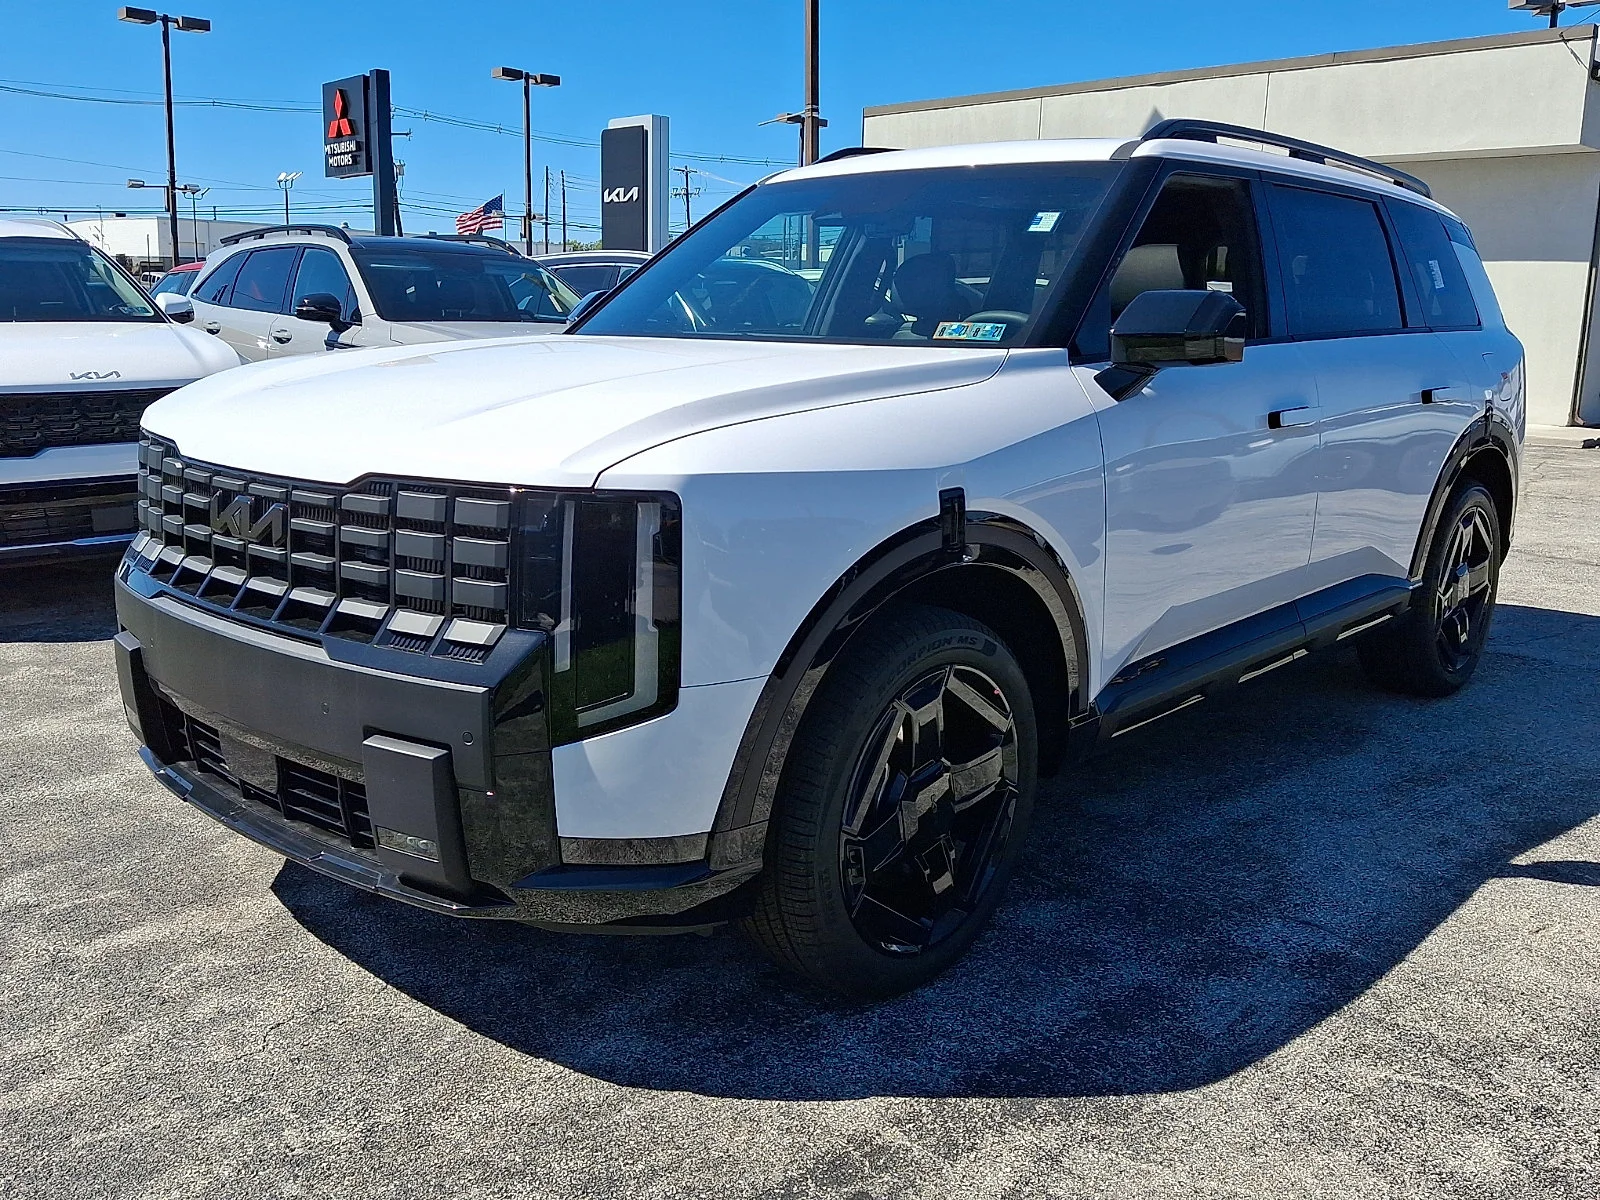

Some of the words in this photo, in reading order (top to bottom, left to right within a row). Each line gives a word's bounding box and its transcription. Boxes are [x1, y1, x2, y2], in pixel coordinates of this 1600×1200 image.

[325, 140, 356, 155] MITSUBISHI
[329, 154, 352, 167] MOTORS
[604, 187, 639, 203] KIA
[69, 370, 121, 380] KIA
[210, 489, 288, 547] KIA
[957, 635, 978, 646] MS
